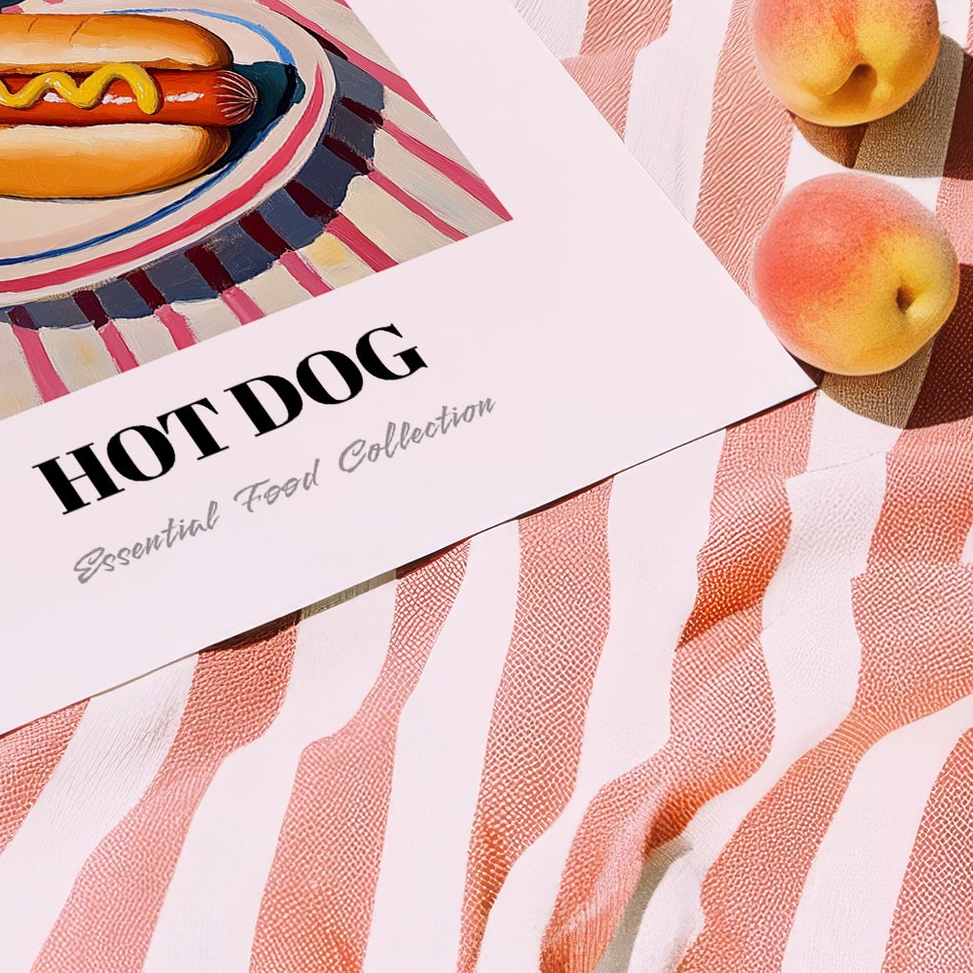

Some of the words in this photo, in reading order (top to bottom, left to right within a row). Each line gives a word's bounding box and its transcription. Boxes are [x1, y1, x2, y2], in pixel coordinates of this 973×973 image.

[31, 397, 230, 516] HOT
[223, 323, 428, 437] DOG
[73, 500, 221, 585] Essential
[232, 458, 321, 514] Food
[338, 397, 497, 474] Collection
